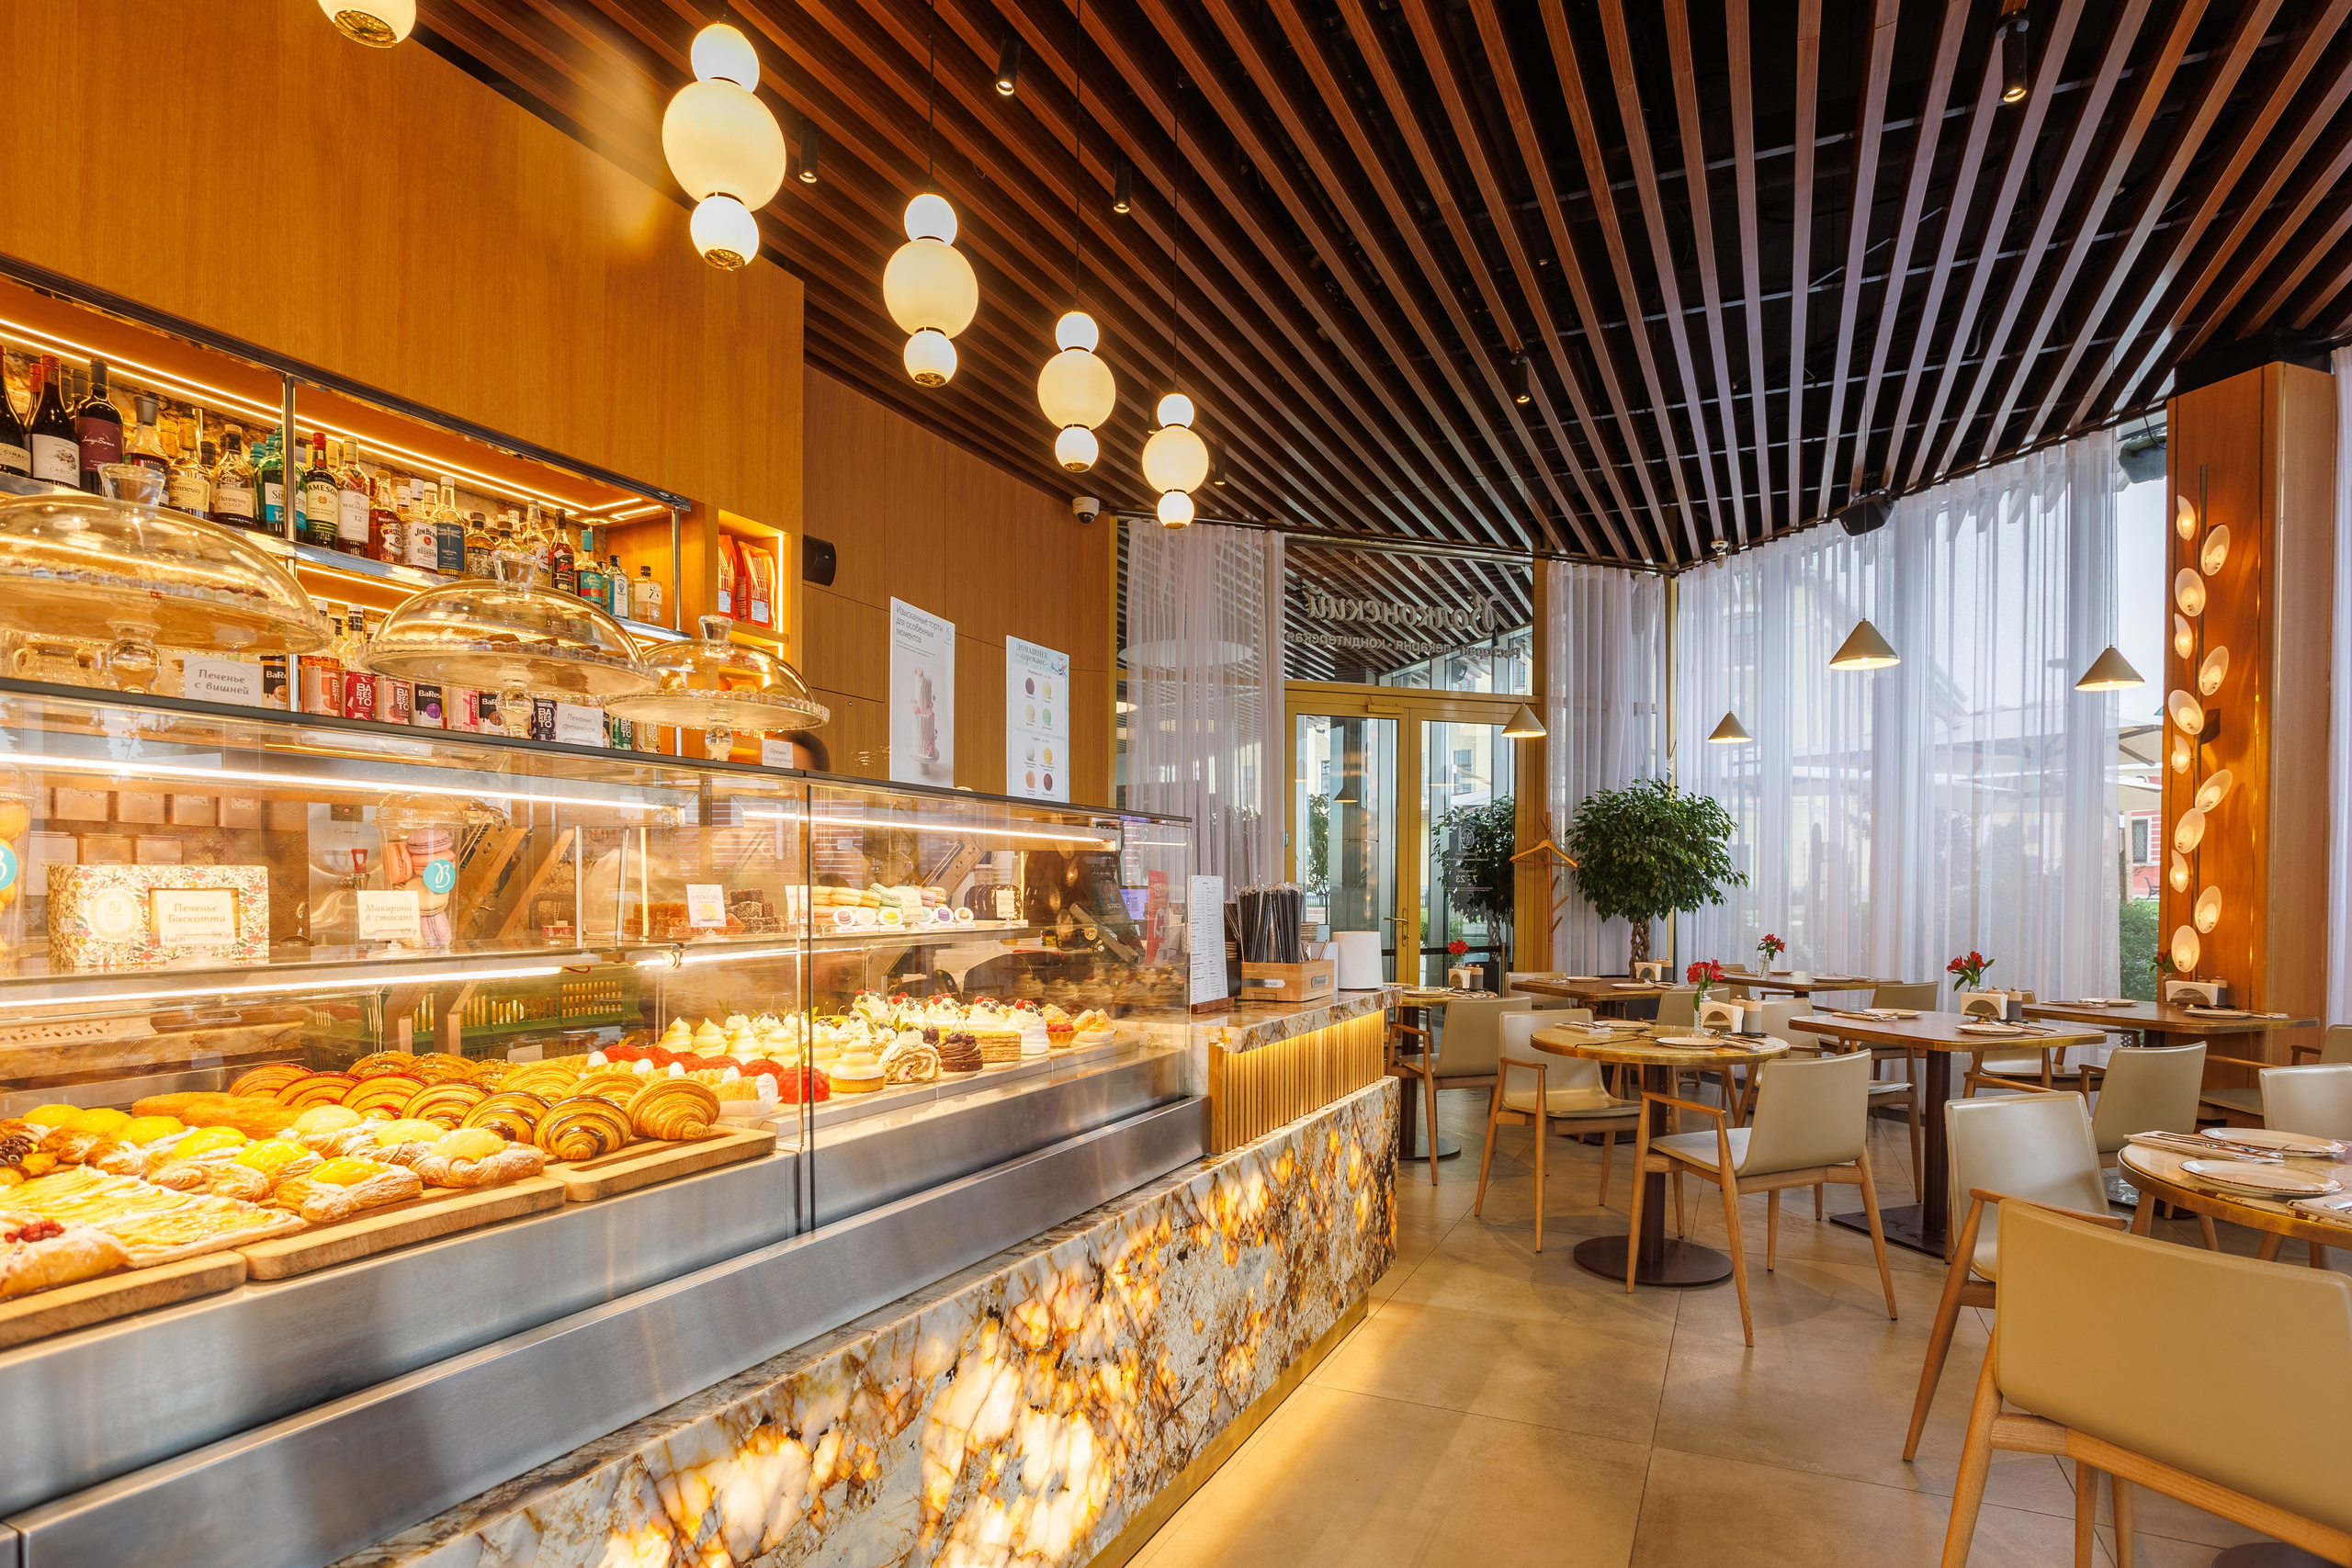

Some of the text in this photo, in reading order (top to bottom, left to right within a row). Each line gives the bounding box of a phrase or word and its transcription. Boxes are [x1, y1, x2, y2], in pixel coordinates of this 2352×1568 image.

[169, 483, 201, 495] Hennessy
[307, 485, 338, 498] AMESON
[218, 495, 246, 505] Hennessy
[354, 514, 362, 523] 12
[414, 527, 425, 536] JIM
[896, 604, 944, 632] Изысканные торты
[896, 617, 935, 638] для особенных
[896, 627, 922, 644] моментов
[198, 669, 245, 684] Печенье
[206, 682, 250, 695] вишней
[356, 682, 372, 693] BA
[396, 687, 409, 697] BA
[356, 691, 372, 699] RES
[357, 697, 372, 706] TO
[398, 702, 410, 711] TO
[537, 707, 551, 716] BA
[567, 713, 593, 724] Печенье
[539, 720, 552, 728] TO
[561, 723, 596, 733] гречишное
[620, 724, 631, 732] RES
[622, 730, 632, 739] TO
[646, 729, 658, 738] RES
[174, 903, 218, 912] Печенье
[365, 904, 413, 914] Макарони
[168, 914, 226, 923] Бискотти
